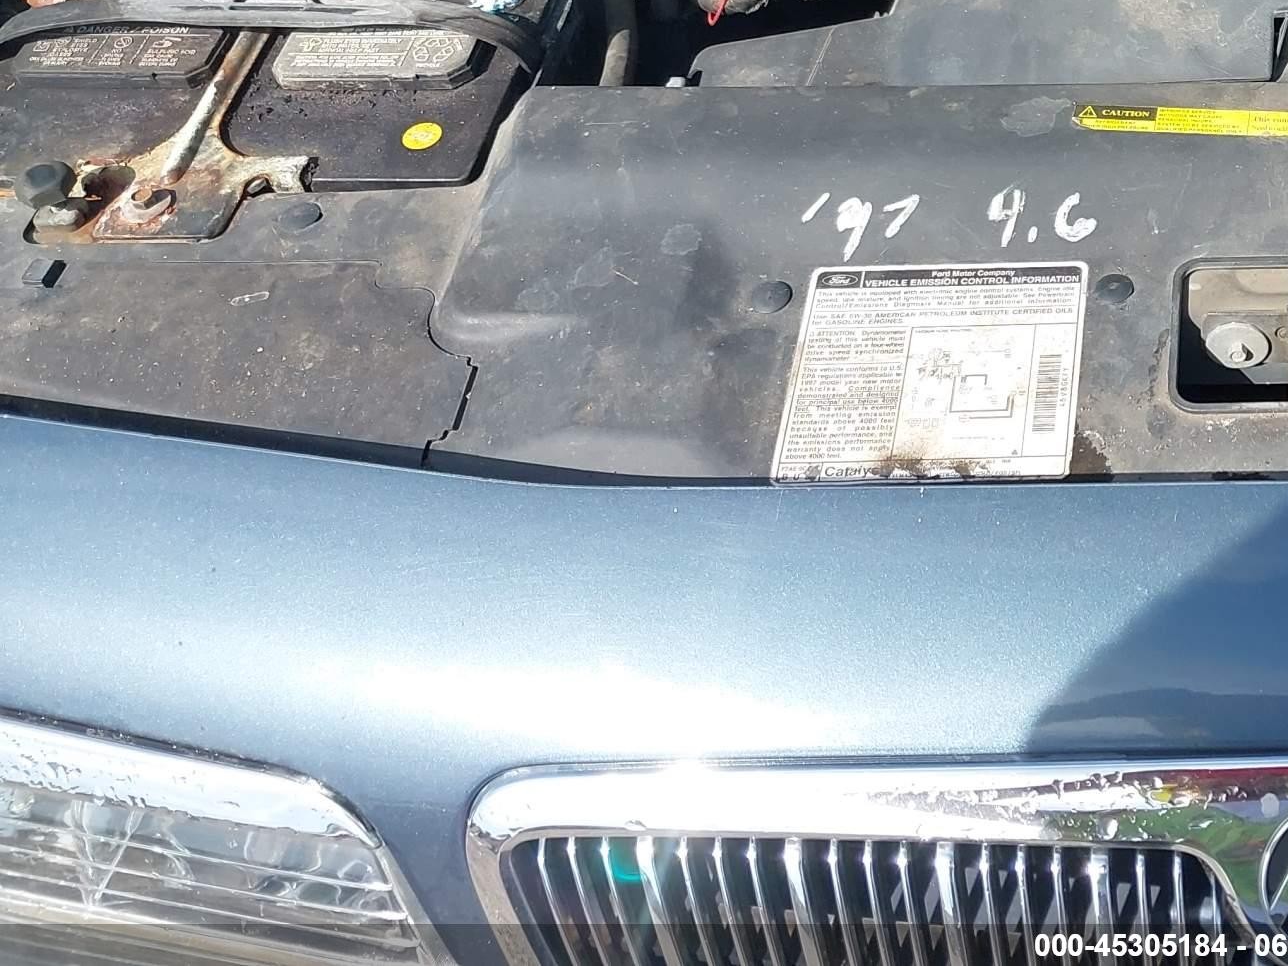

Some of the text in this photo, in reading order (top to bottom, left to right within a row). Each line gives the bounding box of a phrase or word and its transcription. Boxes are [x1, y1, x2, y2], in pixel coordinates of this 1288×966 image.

[1101, 109, 1150, 117] CAUTION
[931, 269, 1016, 278] Ford Motor Company
[864, 275, 1080, 287] VEHICLE EMISSION CONTROL INFORMATION
